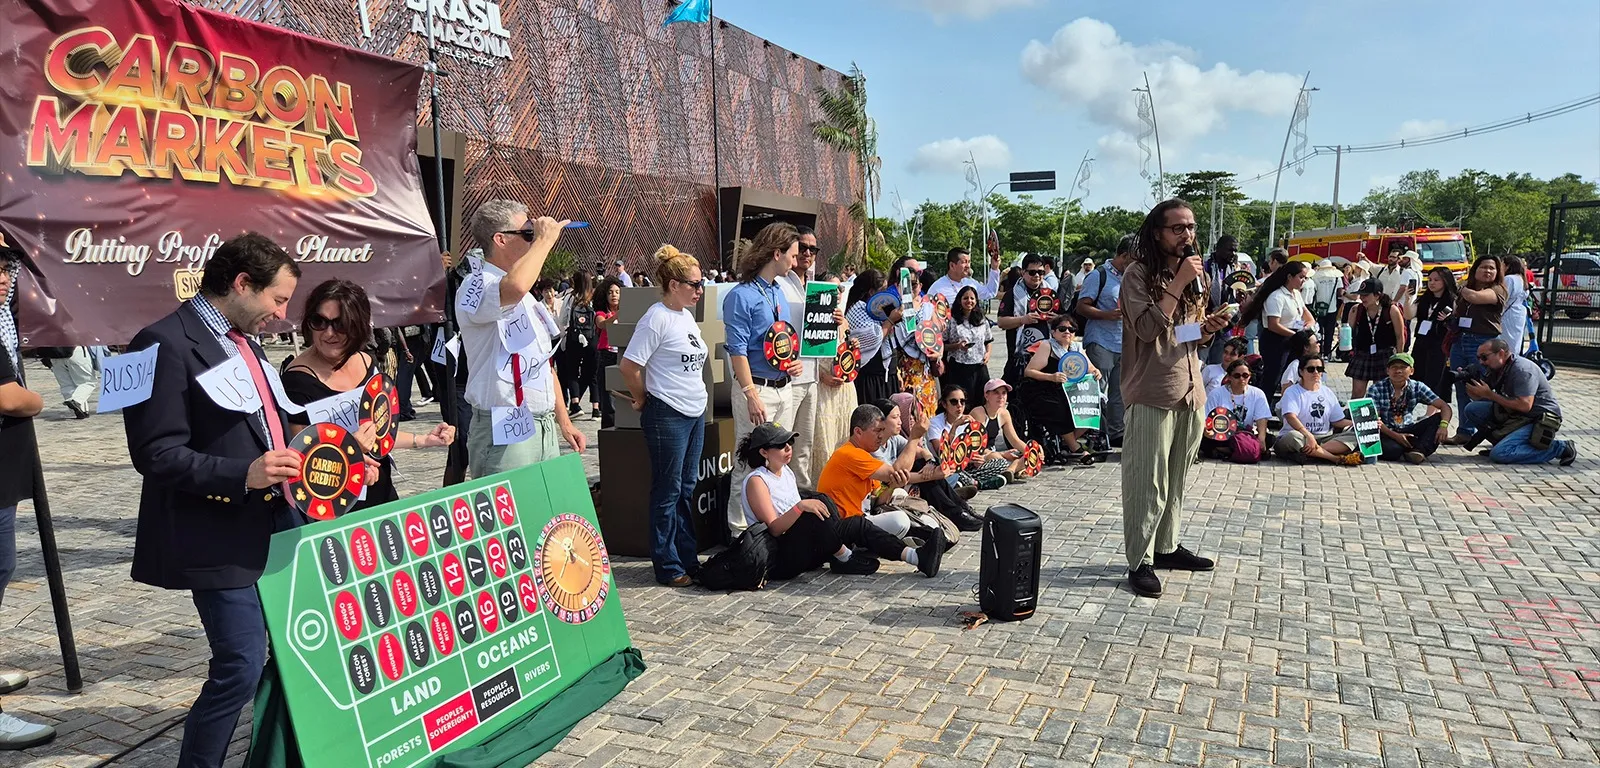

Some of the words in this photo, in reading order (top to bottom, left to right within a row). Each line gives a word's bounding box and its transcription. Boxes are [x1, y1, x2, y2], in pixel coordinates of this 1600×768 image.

[44, 26, 360, 141] CARBON
[27, 95, 377, 197] MARKETS
[63, 228, 152, 275] Putting
[294, 234, 374, 262] Planet
[820, 293, 832, 306] NO
[502, 313, 528, 339] WTO
[807, 312, 834, 324] CARBO
[804, 329, 837, 340] MARKETS
[102, 355, 154, 395] RUSSIA
[215, 366, 255, 407] US
[1077, 382, 1090, 391] NO
[315, 398, 361, 428] JAPA
[503, 419, 531, 438] POLE
[311, 457, 343, 475] CARBON
[697, 457, 716, 481] UN
[309, 471, 341, 488] CREDITS
[454, 506, 473, 532] 18
[476, 501, 493, 523] 21
[497, 492, 514, 520] 24
[384, 525, 394, 545] RIVER
[408, 521, 426, 547] 12
[432, 514, 450, 539] 15
[326, 537, 342, 584] SUNDALAND
[355, 540, 365, 567] GUINEA
[361, 535, 373, 567] FORESTS
[391, 544, 399, 561] NILE
[488, 543, 506, 574] 20
[508, 537, 525, 565] 23
[445, 561, 463, 588] 14
[467, 557, 484, 578] 17
[395, 579, 407, 611] YANGTZE
[403, 583, 413, 603] RIVER
[422, 571, 432, 598] DANUM
[427, 571, 437, 596] VALLEY
[520, 580, 537, 607] 22
[347, 602, 357, 625] BASIN
[370, 583, 386, 626] HIMALAYAS
[479, 600, 496, 625] 16
[501, 591, 516, 615] 19
[339, 602, 351, 632] CONGO
[458, 609, 475, 636] 13
[416, 633, 425, 654] RIVER
[441, 621, 450, 641] RIVER
[384, 635, 399, 678] SUNDERBANS
[409, 629, 421, 661] AMAZON
[477, 625, 539, 669] OCEANS
[353, 654, 366, 687] AMAZON
[360, 654, 372, 682] FOREST
[524, 661, 551, 683] RIVERS
[390, 676, 442, 716] LAND
[480, 685, 515, 710] RESOURCES
[483, 680, 509, 699] PEOPLES
[429, 708, 474, 740] SOVEREIGNTY
[435, 706, 464, 726] PEOPLES
[376, 735, 423, 768] FORESTS
